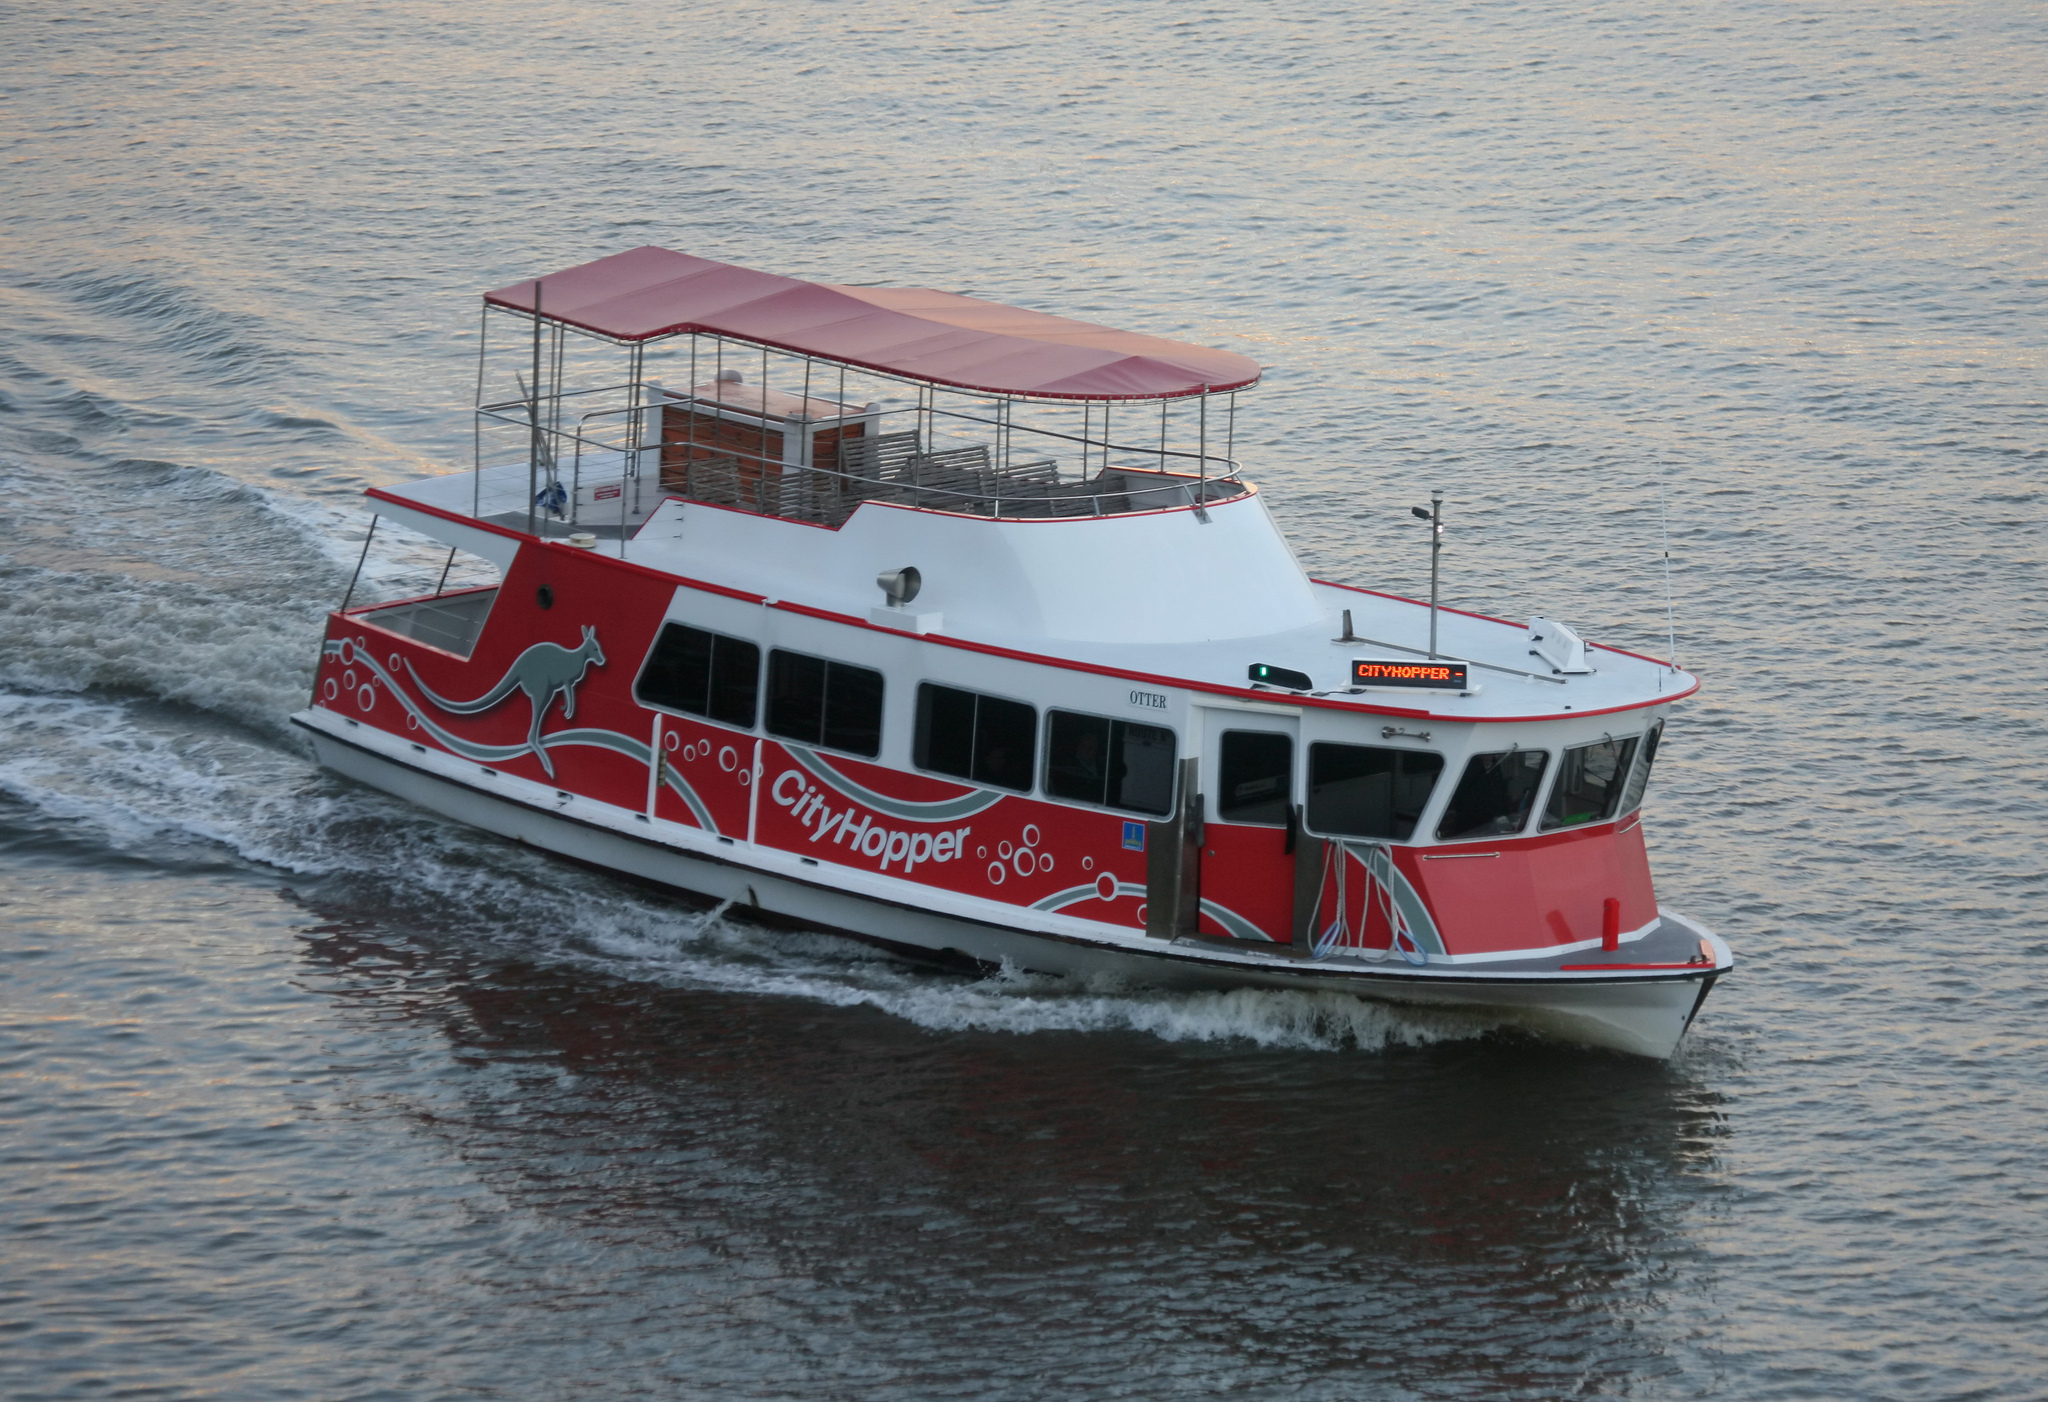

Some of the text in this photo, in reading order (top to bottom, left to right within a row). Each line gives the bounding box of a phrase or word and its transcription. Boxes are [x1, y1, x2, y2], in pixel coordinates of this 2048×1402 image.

[1358, 664, 1450, 680] CITYHOPPER
[1130, 690, 1166, 708] OTTER
[771, 769, 971, 873] CityHopper
